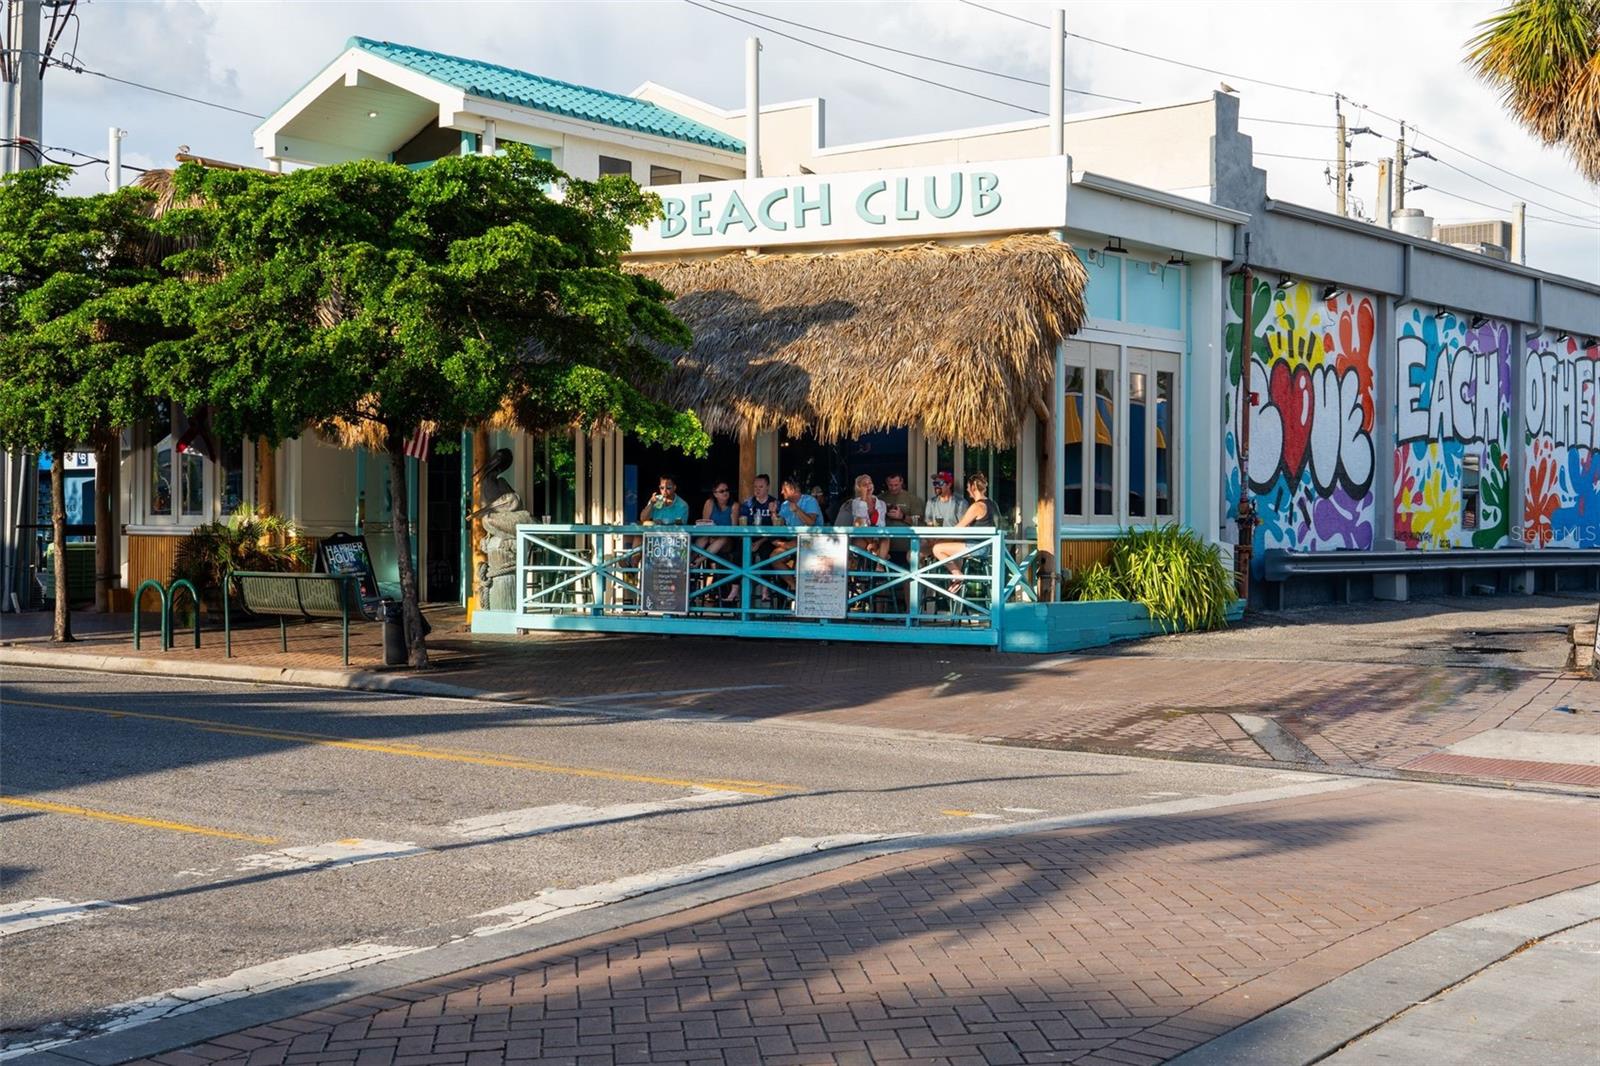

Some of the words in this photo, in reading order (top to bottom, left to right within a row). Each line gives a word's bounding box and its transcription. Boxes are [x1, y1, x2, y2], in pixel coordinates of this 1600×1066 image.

[660, 182, 831, 239] BEACH
[855, 171, 1002, 226] CLUB
[1397, 335, 1500, 447] EACH
[325, 542, 365, 553] HAPPIER
[647, 537, 687, 548] HAPPIER
[329, 551, 356, 564] HOUR
[647, 546, 674, 558] HOUR
